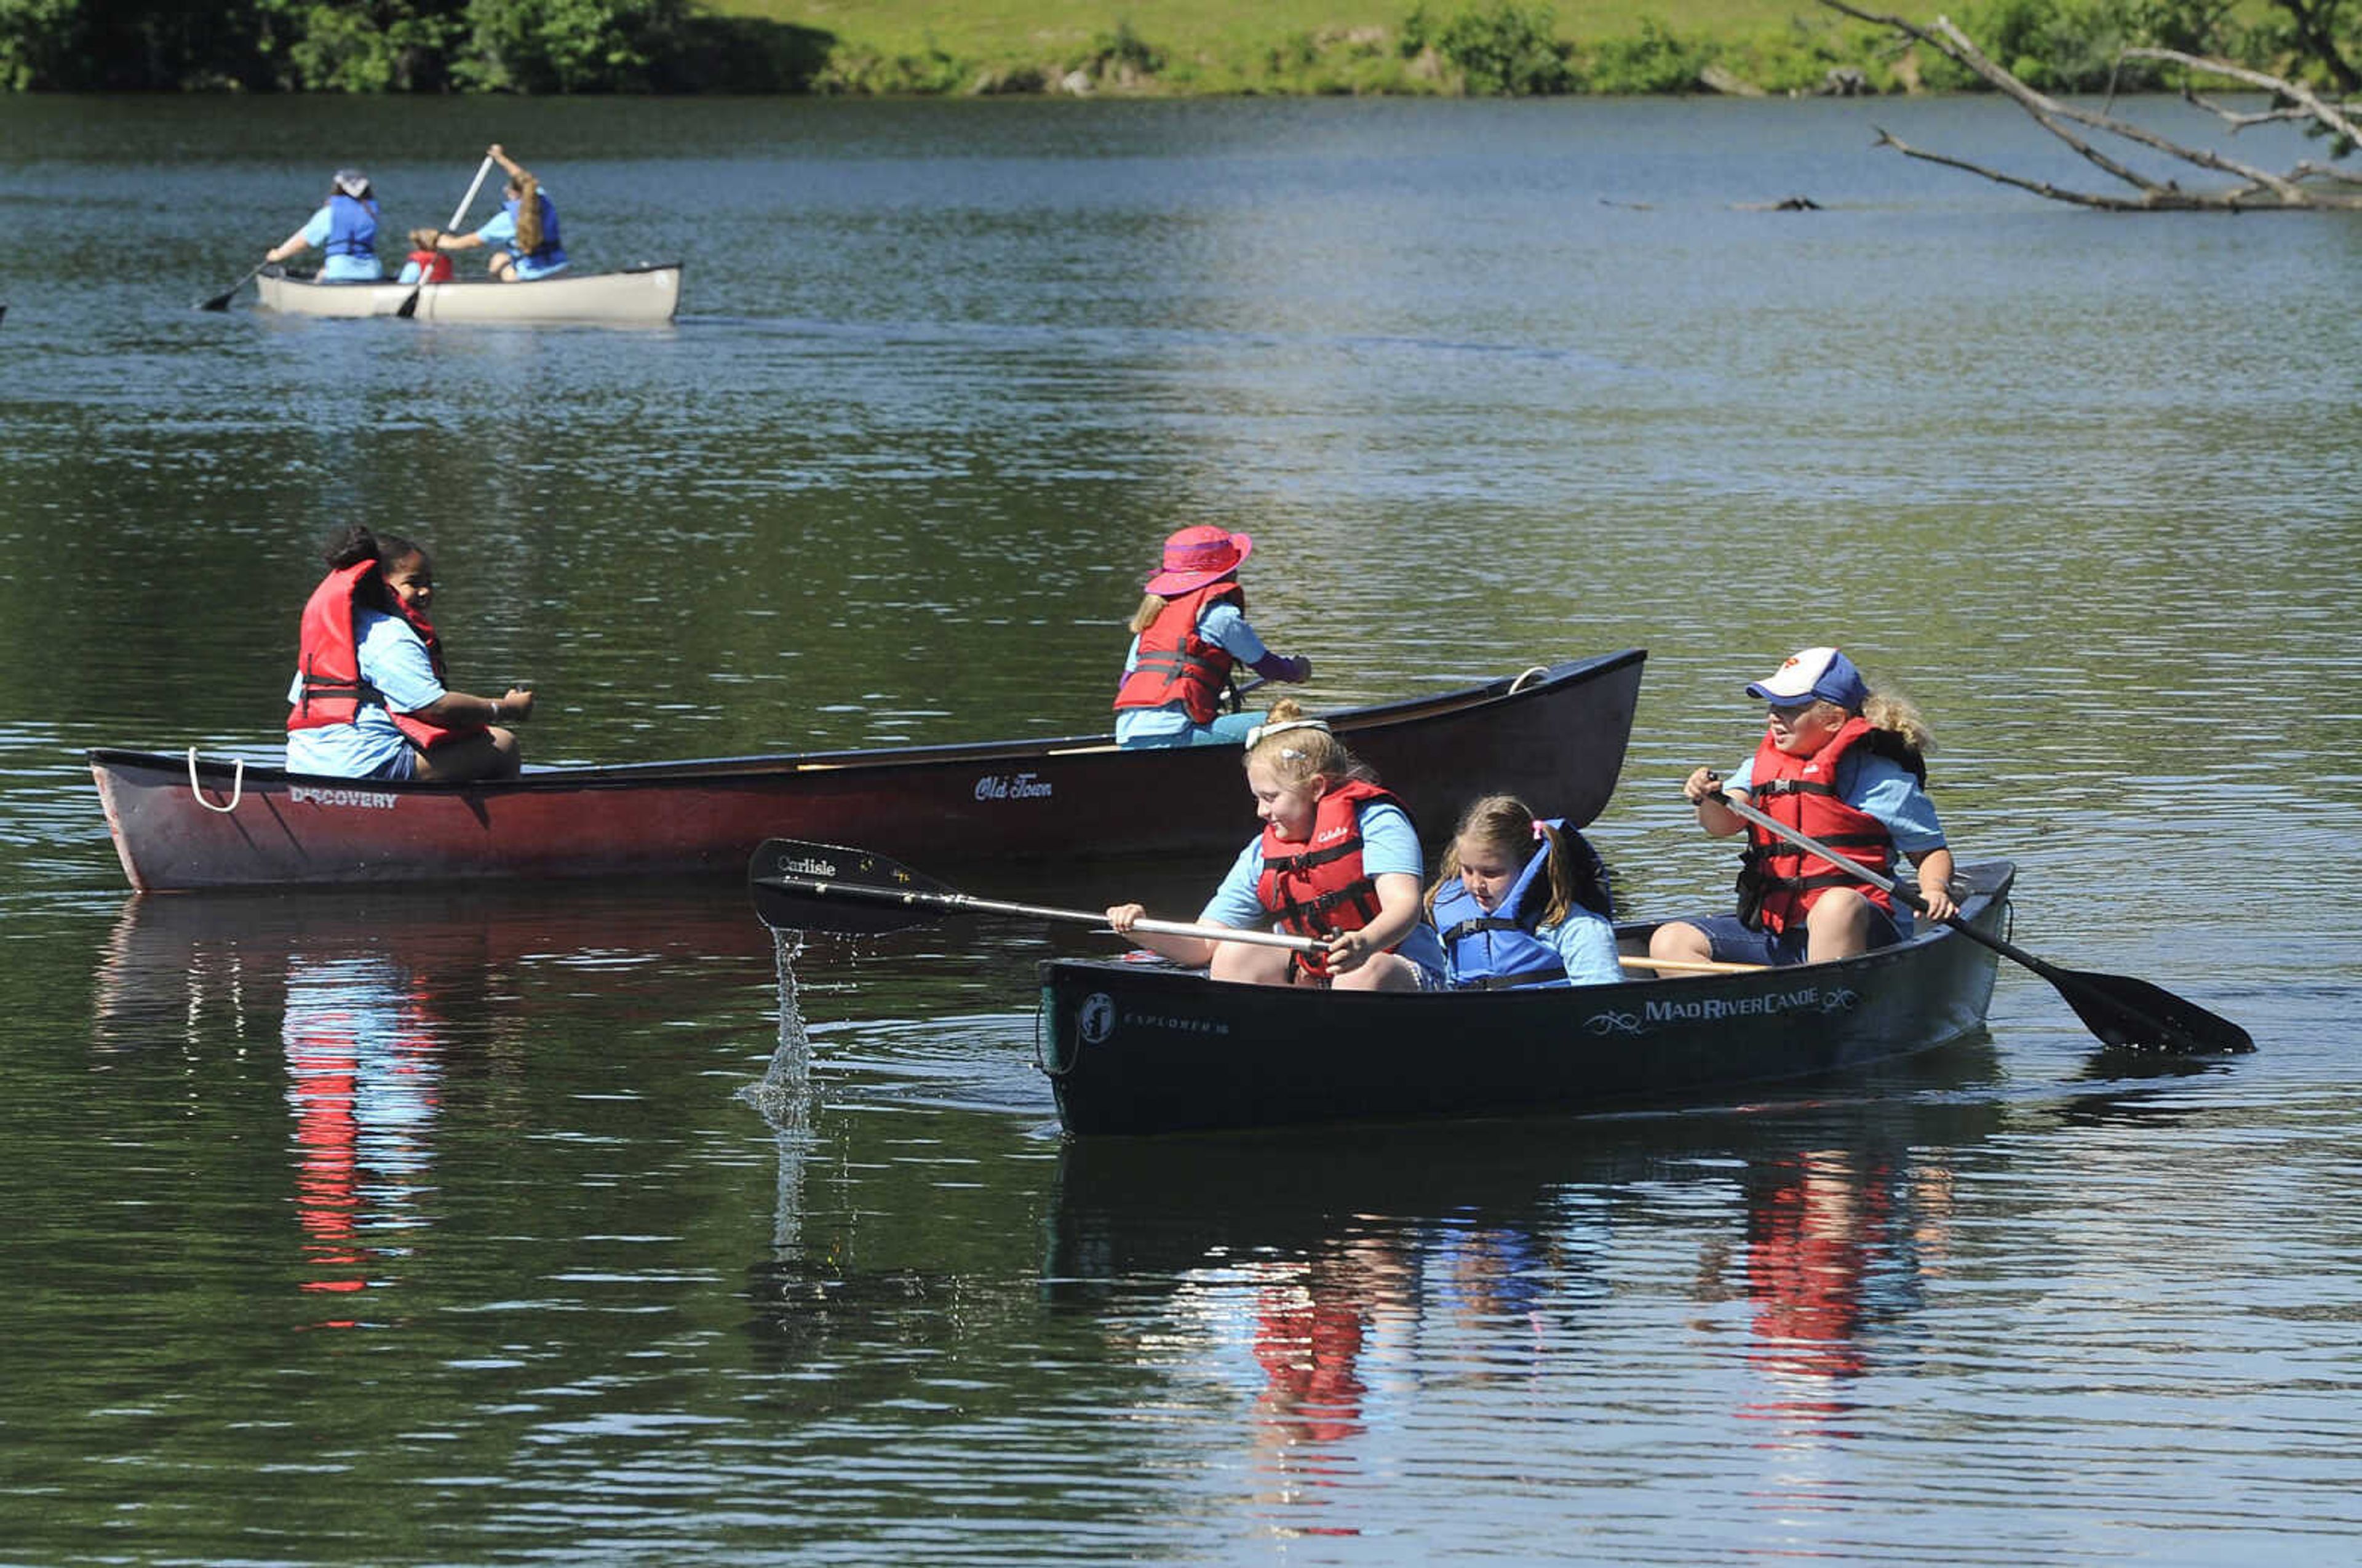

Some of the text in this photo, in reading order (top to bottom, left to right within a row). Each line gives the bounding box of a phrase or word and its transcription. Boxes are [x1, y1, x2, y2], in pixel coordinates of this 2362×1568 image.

[975, 773, 1052, 800] Old Town
[778, 856, 836, 877] Carlisle
